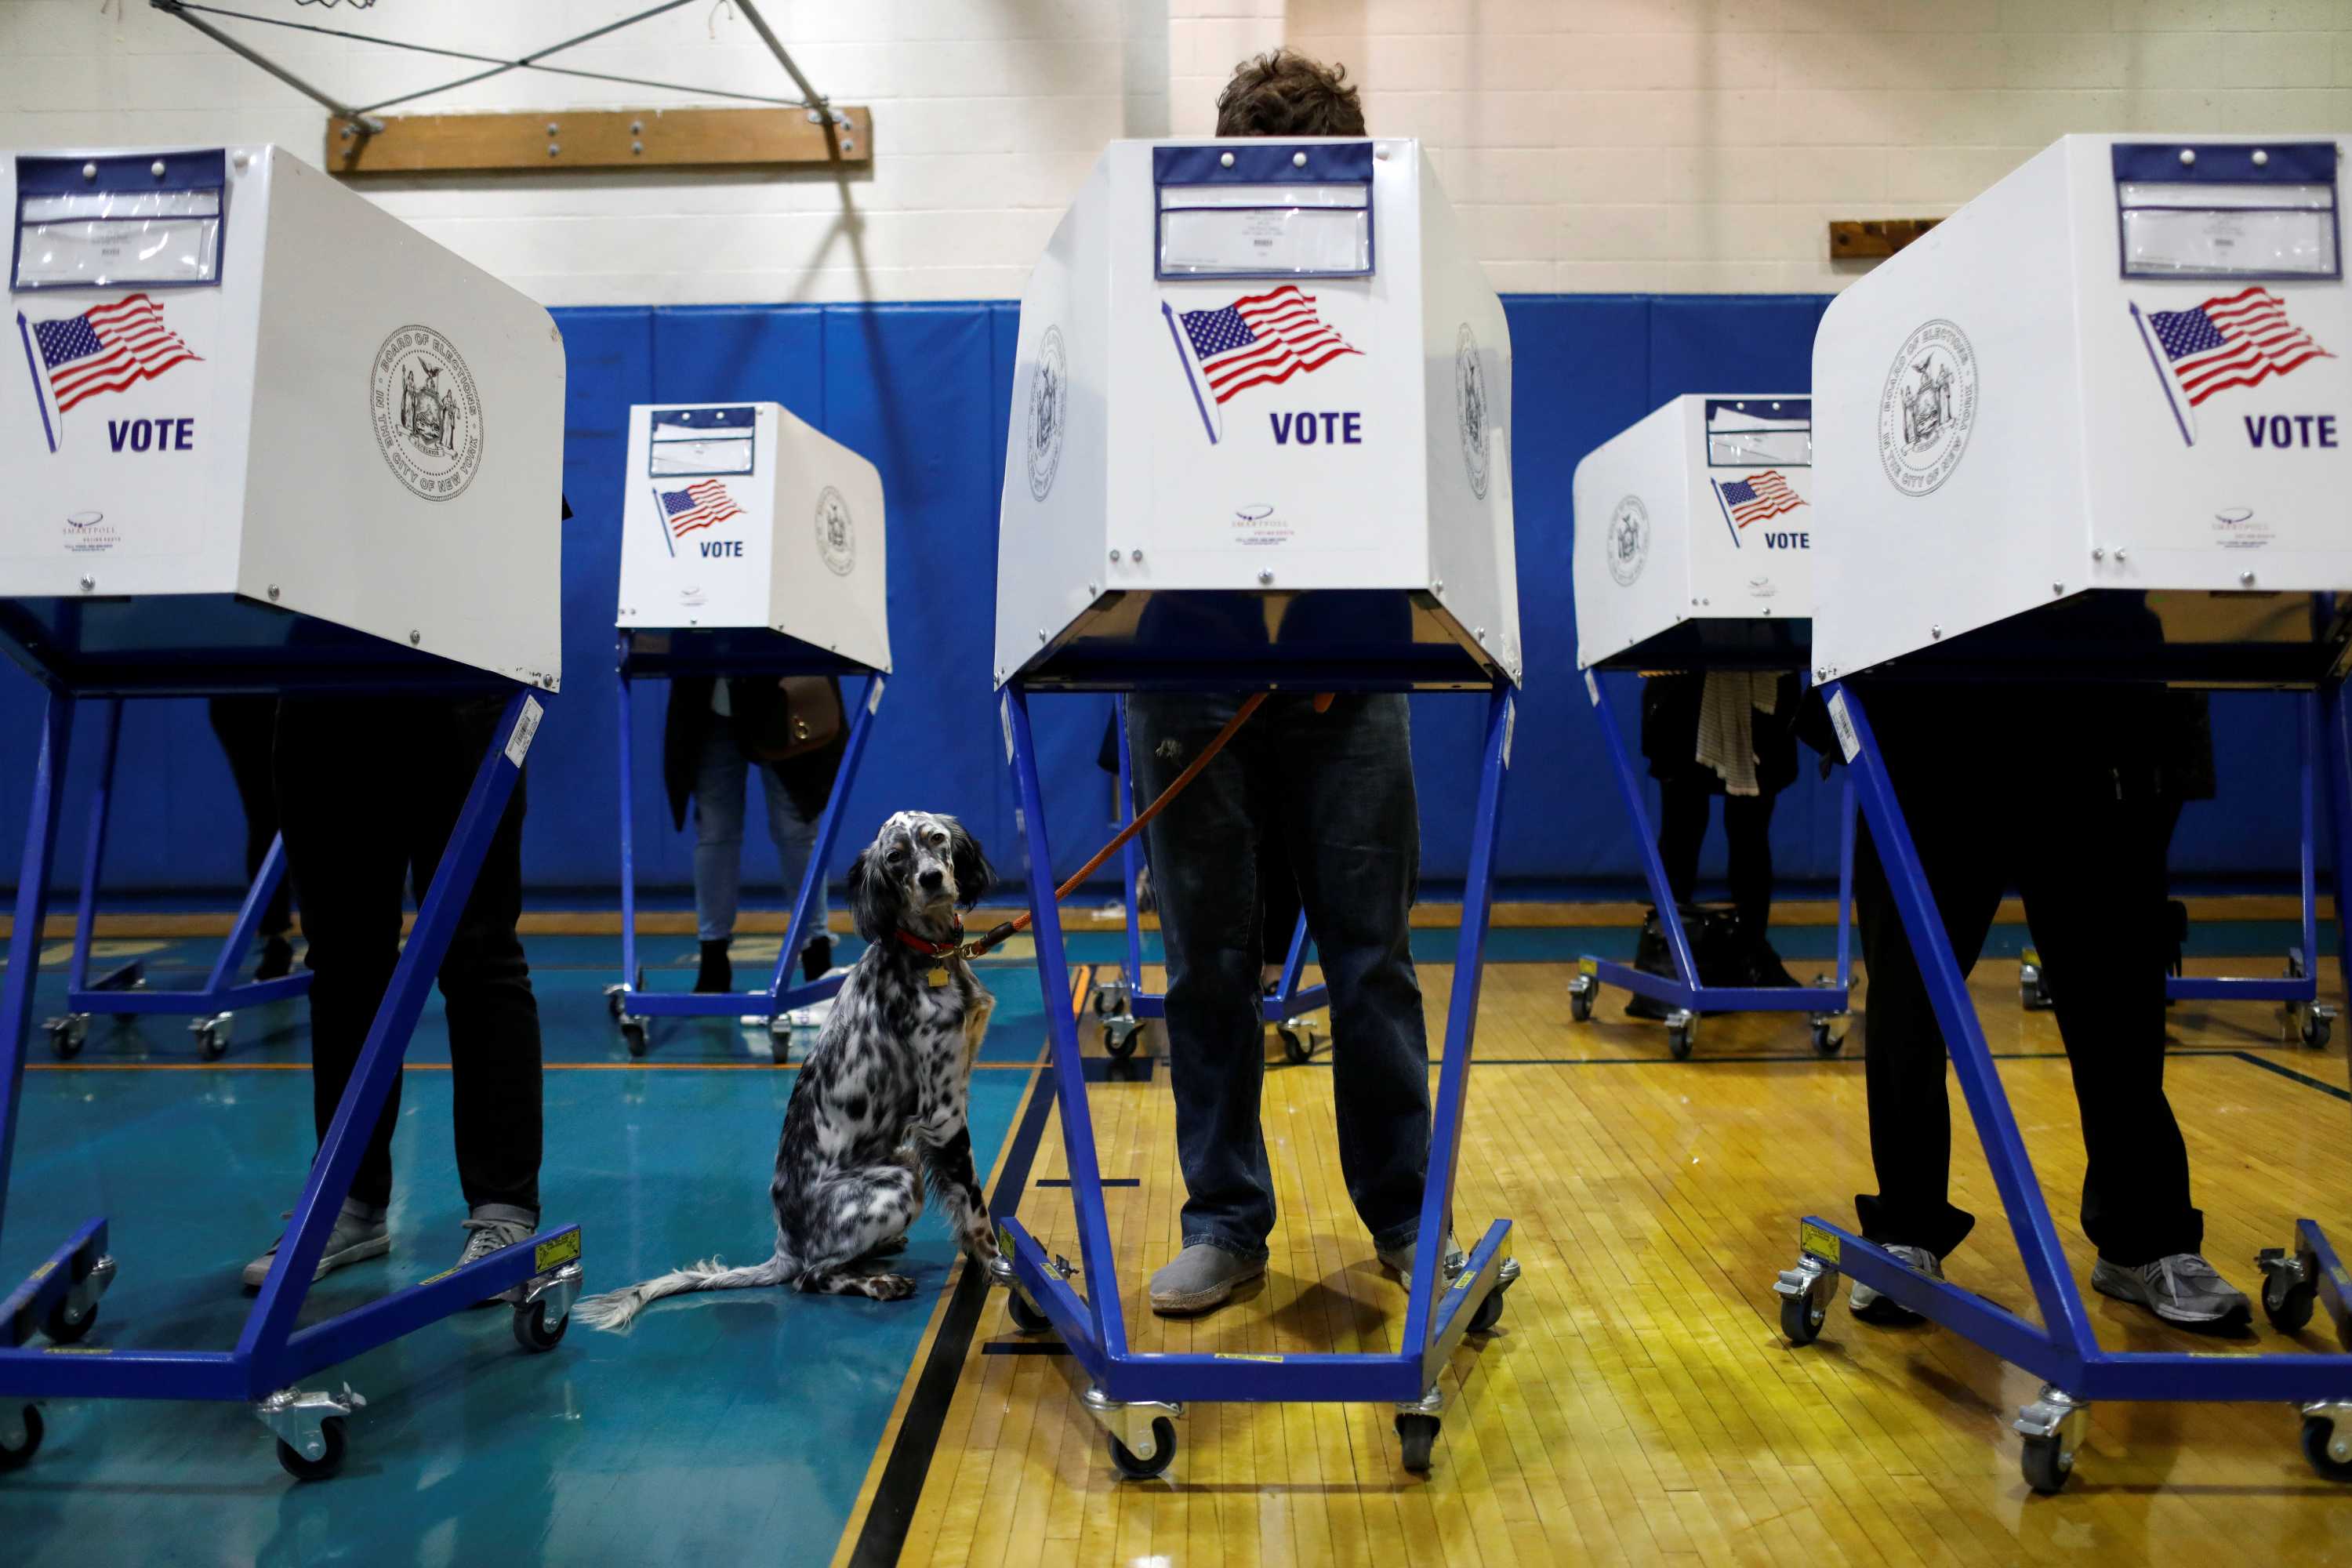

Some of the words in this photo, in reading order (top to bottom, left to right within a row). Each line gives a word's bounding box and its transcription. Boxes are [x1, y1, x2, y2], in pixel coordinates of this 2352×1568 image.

[380, 334, 412, 373] BOARD
[415, 332, 430, 346] OF
[432, 339, 477, 416] ELECTIONS
[376, 390, 385, 408] IN
[108, 418, 194, 452] VOTE
[377, 413, 394, 449] THE
[1269, 412, 1362, 445] VOTE
[2244, 415, 2339, 448] VOTE
[392, 452, 419, 484] CITY
[459, 435, 478, 475] YORK
[420, 477, 436, 492] OF
[437, 471, 461, 493] NEW
[700, 541, 743, 557] VOTE
[1765, 532, 1809, 549] VOTE
